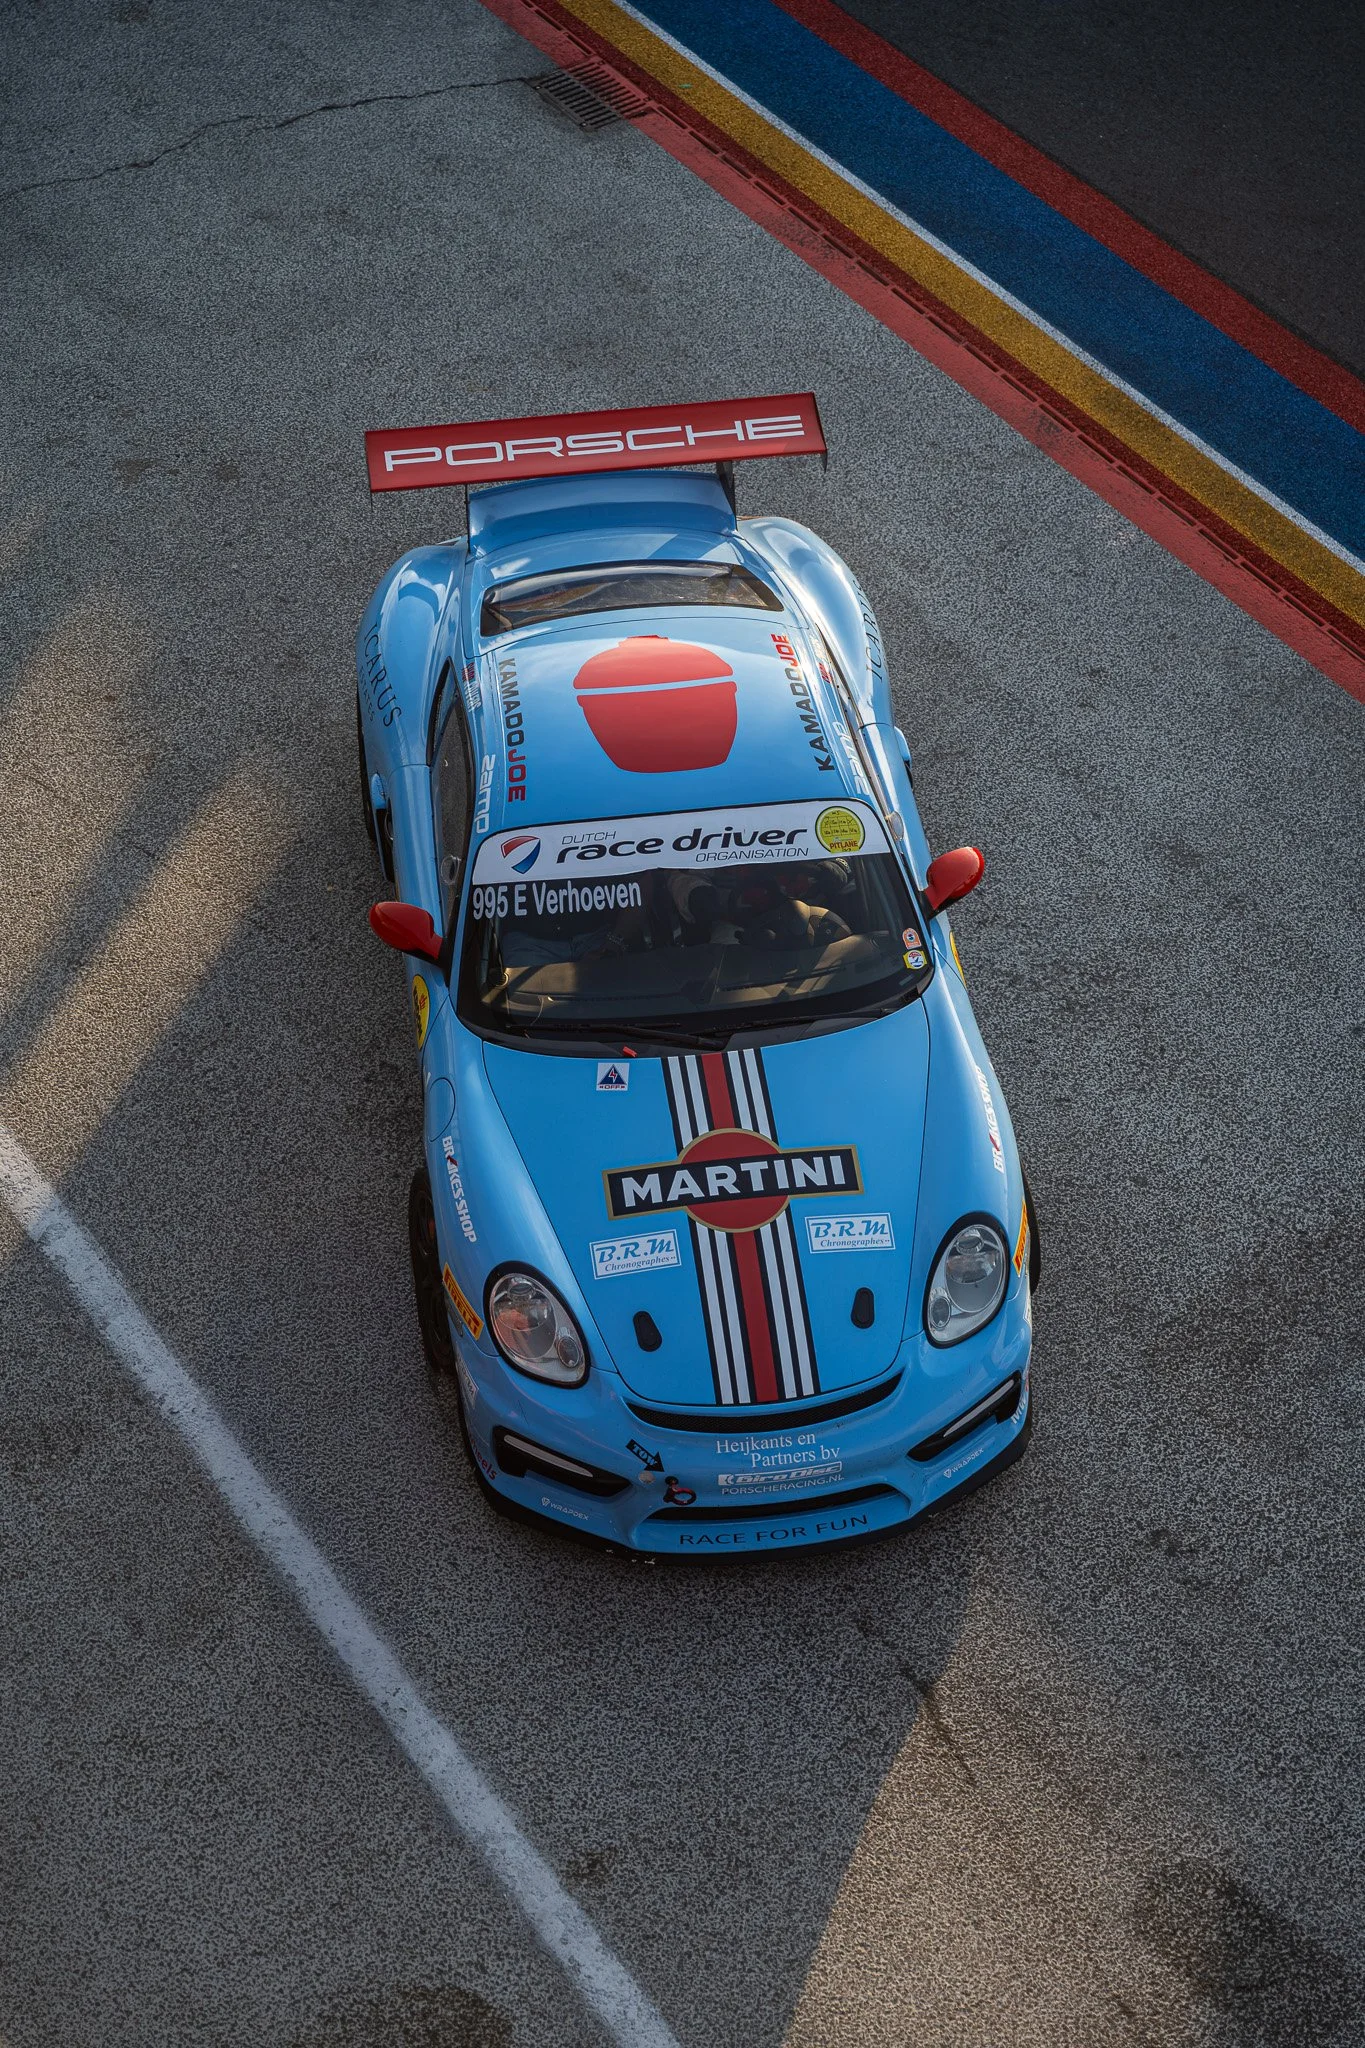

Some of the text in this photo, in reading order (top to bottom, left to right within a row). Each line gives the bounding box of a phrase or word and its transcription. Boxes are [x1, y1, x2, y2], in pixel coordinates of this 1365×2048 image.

[384, 414, 804, 472] PORSCHE
[365, 624, 402, 728] ICARUS
[556, 826, 808, 864] race driver
[561, 831, 616, 845] DUTCH
[695, 848, 809, 863] ORGANISATION
[473, 880, 642, 920] 995 E Verhoeven
[621, 1155, 846, 1208] MARTINI
[811, 1219, 889, 1238] B.R.M
[596, 1238, 674, 1263] B.R.M
[716, 1432, 817, 1456] Heijkants en
[751, 1445, 841, 1468] Partners bv
[721, 1474, 845, 1495] PORSCHERACING.NL
[679, 1514, 868, 1545] RACE FOR FUN
